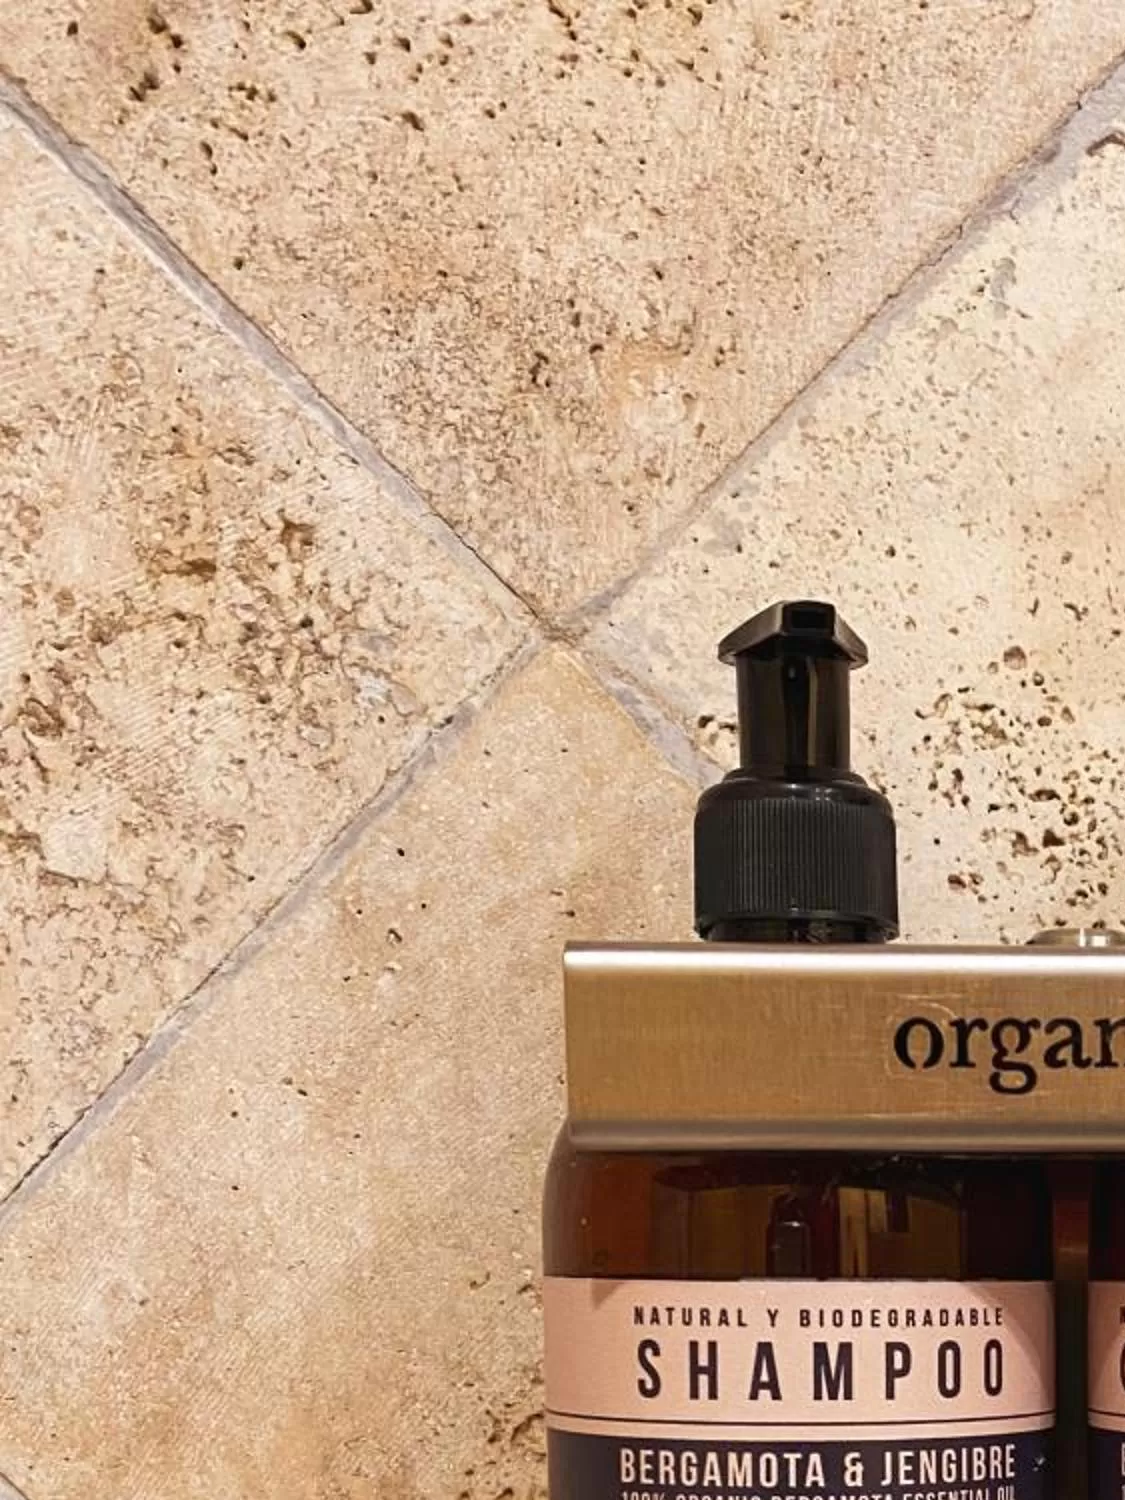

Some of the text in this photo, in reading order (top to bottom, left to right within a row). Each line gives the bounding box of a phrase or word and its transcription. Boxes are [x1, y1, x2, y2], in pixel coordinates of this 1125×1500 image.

[633, 1307, 1002, 1328] NATURAL Y BIODEGRADABLE
[637, 1338, 1002, 1400] SHAMPOO
[620, 1444, 1016, 1488] BERGAMOTA & JENGIBRE
